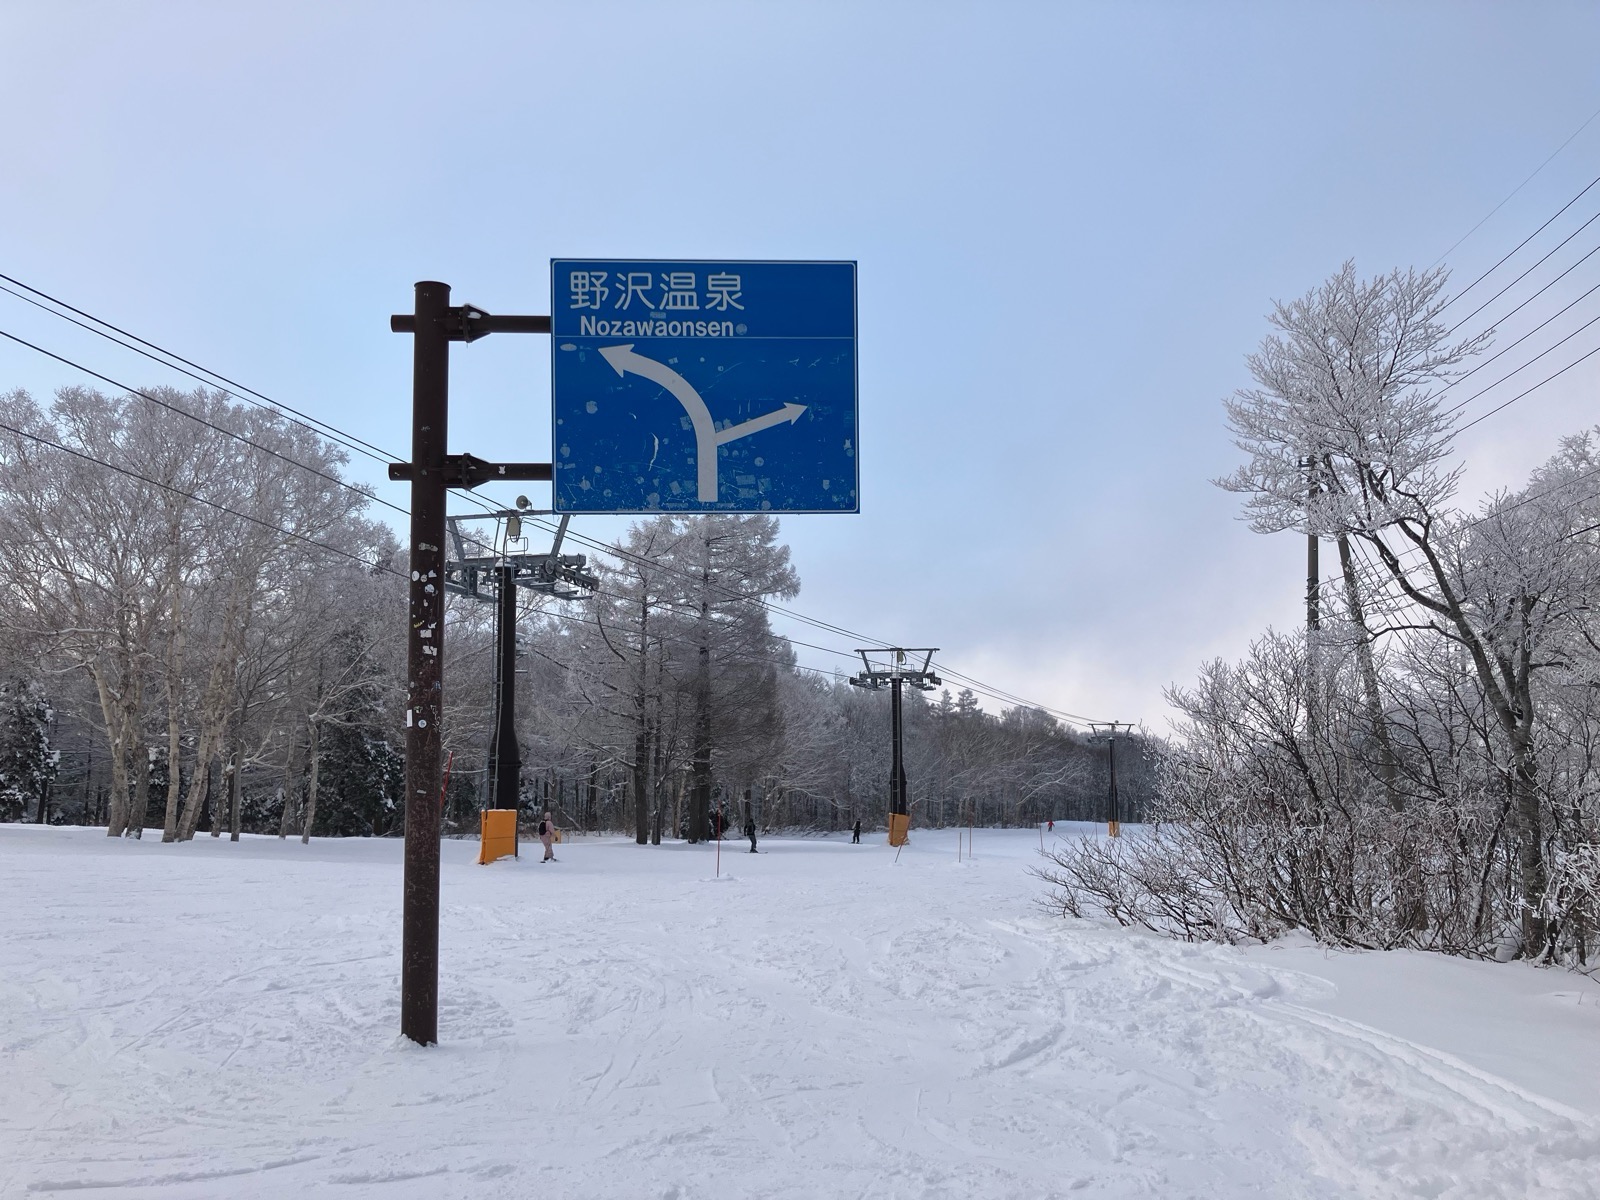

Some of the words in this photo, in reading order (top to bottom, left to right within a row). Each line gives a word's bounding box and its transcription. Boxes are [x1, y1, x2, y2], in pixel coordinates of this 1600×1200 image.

[570, 271, 745, 311] 野沢温泉
[580, 315, 734, 337] Nozawaonsen
